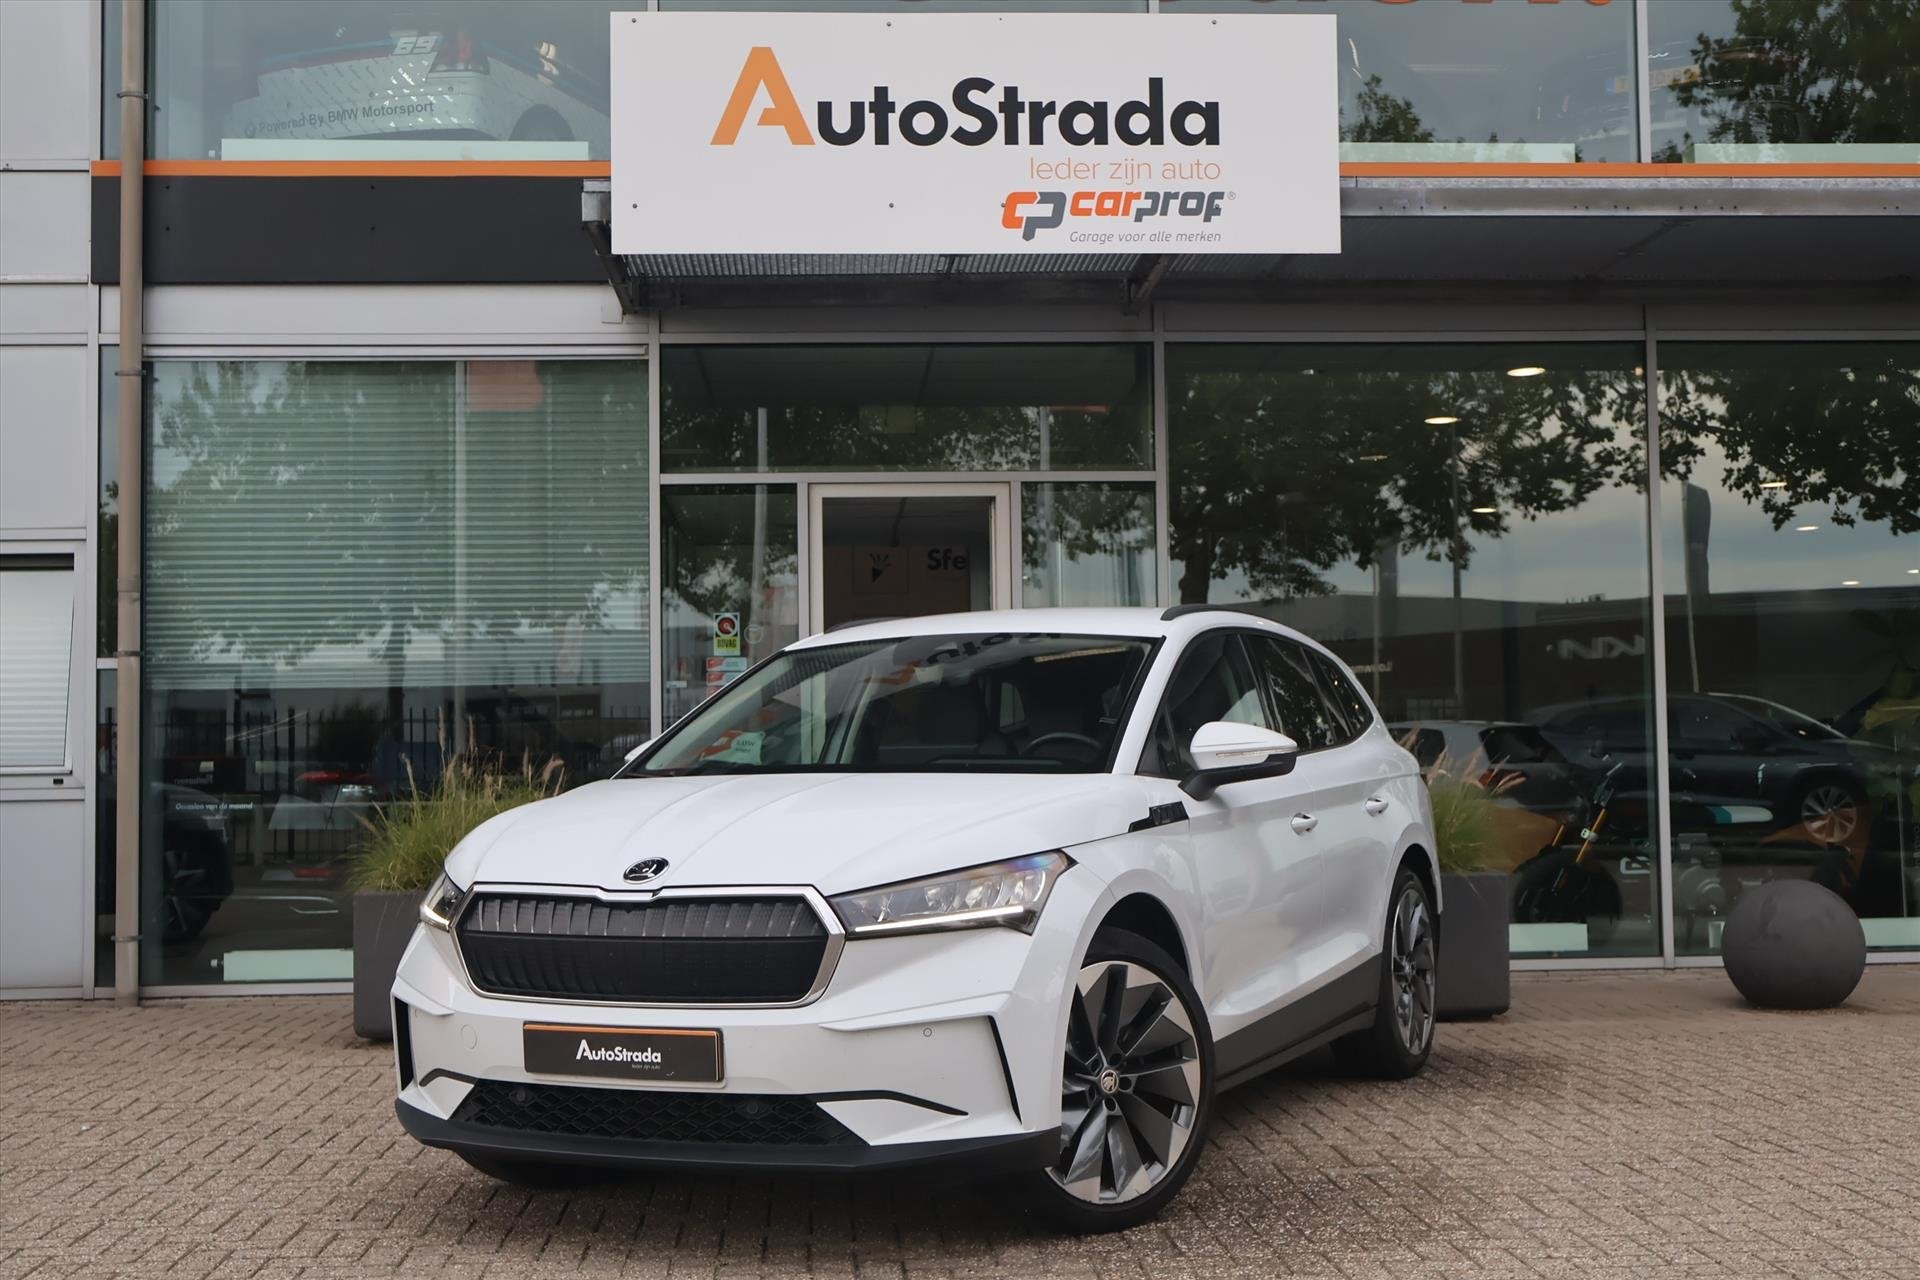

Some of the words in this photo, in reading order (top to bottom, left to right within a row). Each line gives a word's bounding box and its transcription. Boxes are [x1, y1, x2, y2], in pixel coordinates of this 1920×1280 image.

[710, 46, 1220, 146] AutoStrada
[258, 111, 307, 133] Powered
[308, 112, 325, 128] By
[328, 107, 359, 123] BMW
[362, 101, 435, 118] Motorsport
[1030, 157, 1101, 180] Ieder
[1109, 157, 1152, 185] zijn
[1161, 160, 1222, 180] auto
[1069, 190, 1226, 223] carprof
[1069, 231, 1114, 244] Garage
[1118, 232, 1145, 243] voor
[1149, 231, 1172, 242] alle
[1175, 231, 1222, 243] merken
[576, 1039, 661, 1063] AutoStrada
